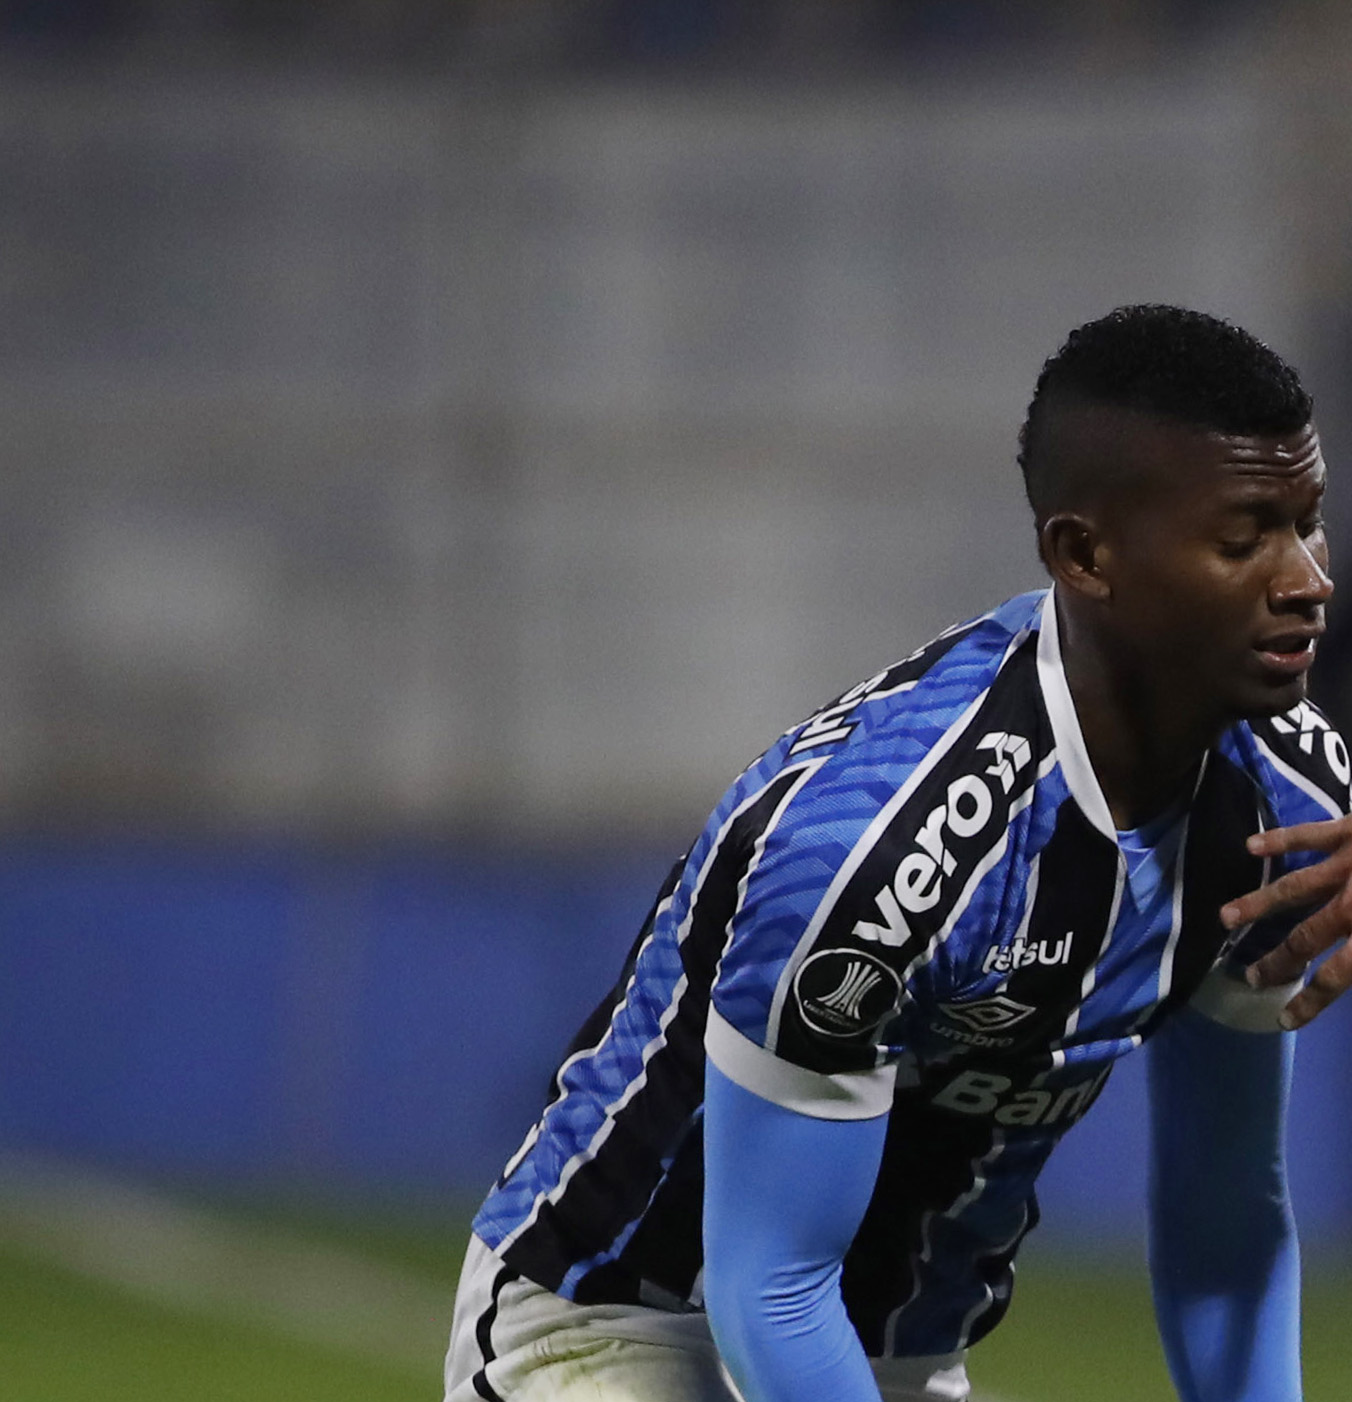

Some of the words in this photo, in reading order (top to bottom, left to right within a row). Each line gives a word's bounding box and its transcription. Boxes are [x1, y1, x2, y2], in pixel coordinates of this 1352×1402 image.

[851, 774, 993, 947] vero
[929, 1021, 1015, 1048] umbro
[930, 1062, 1112, 1126] Ban
